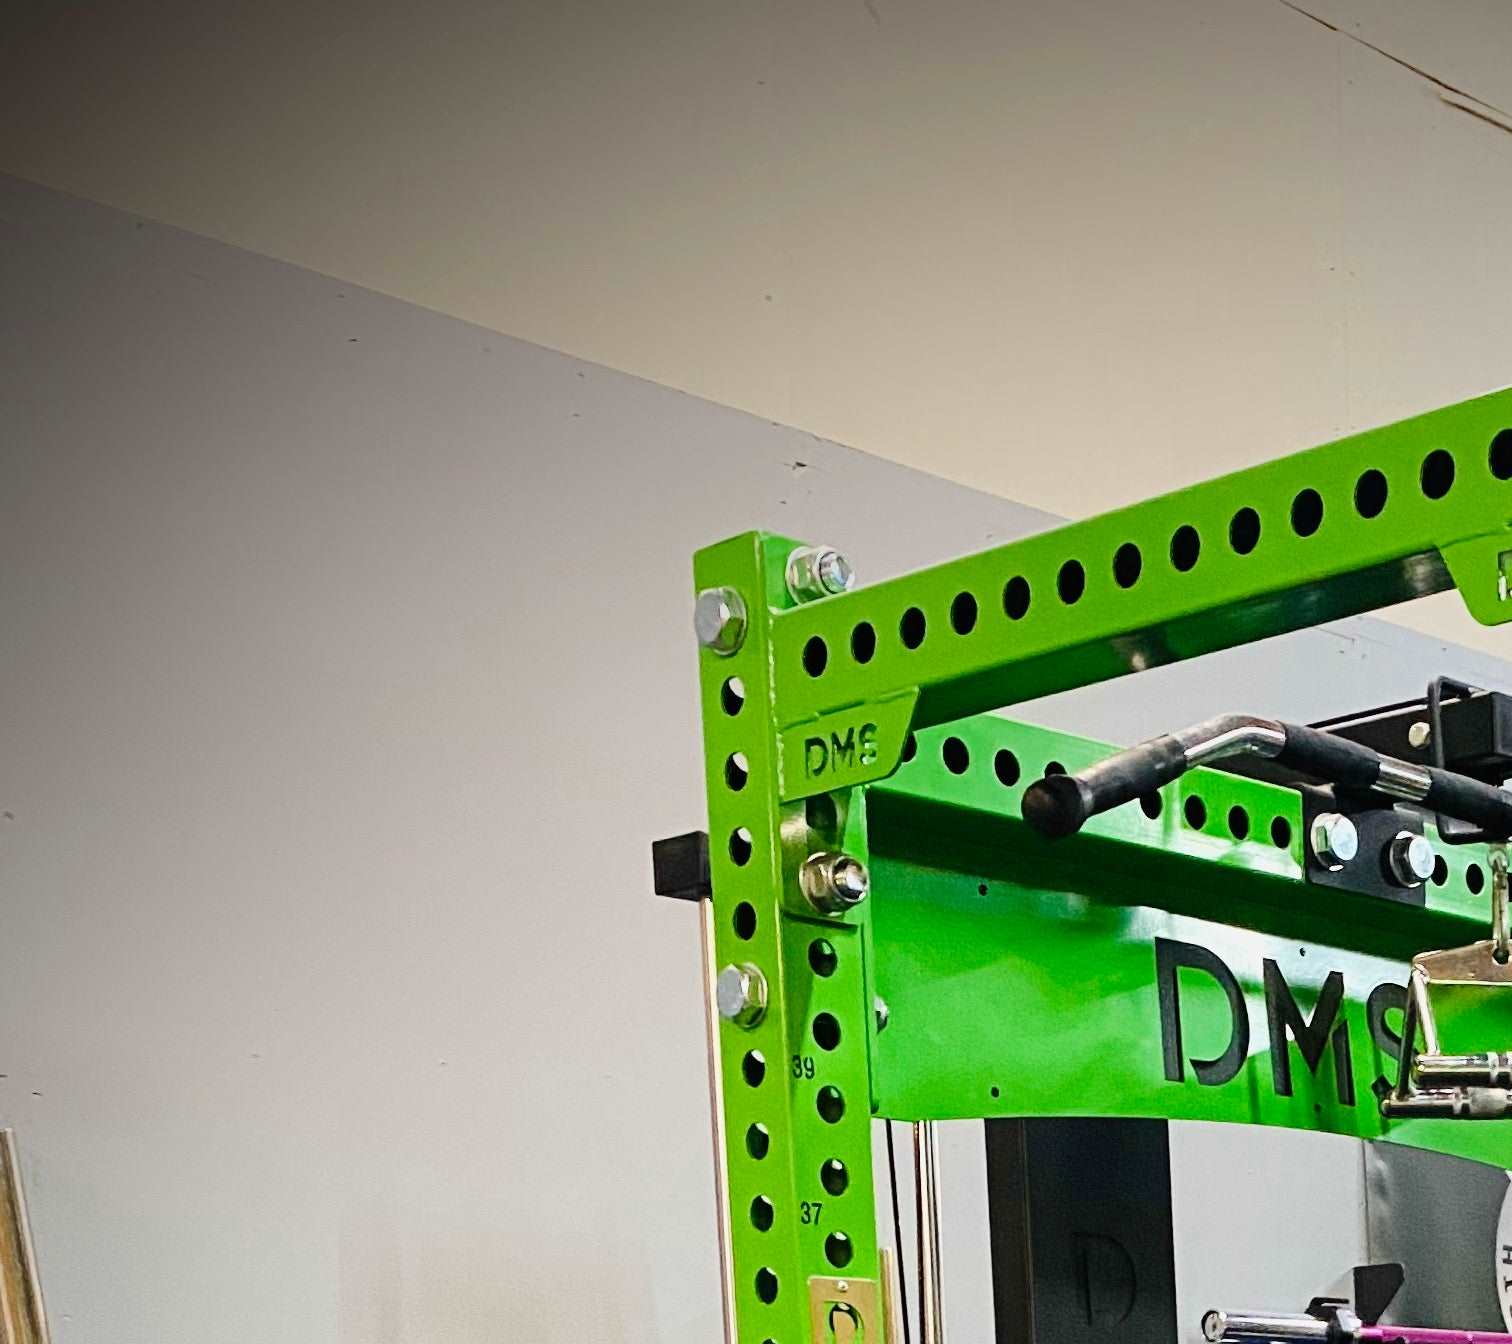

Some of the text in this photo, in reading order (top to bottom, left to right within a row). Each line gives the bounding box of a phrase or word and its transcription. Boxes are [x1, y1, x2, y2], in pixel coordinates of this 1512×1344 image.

[804, 722, 878, 777] DMS
[1154, 936, 1418, 1108] DMS
[791, 1053, 815, 1081] 39
[799, 1201, 823, 1227] 37
